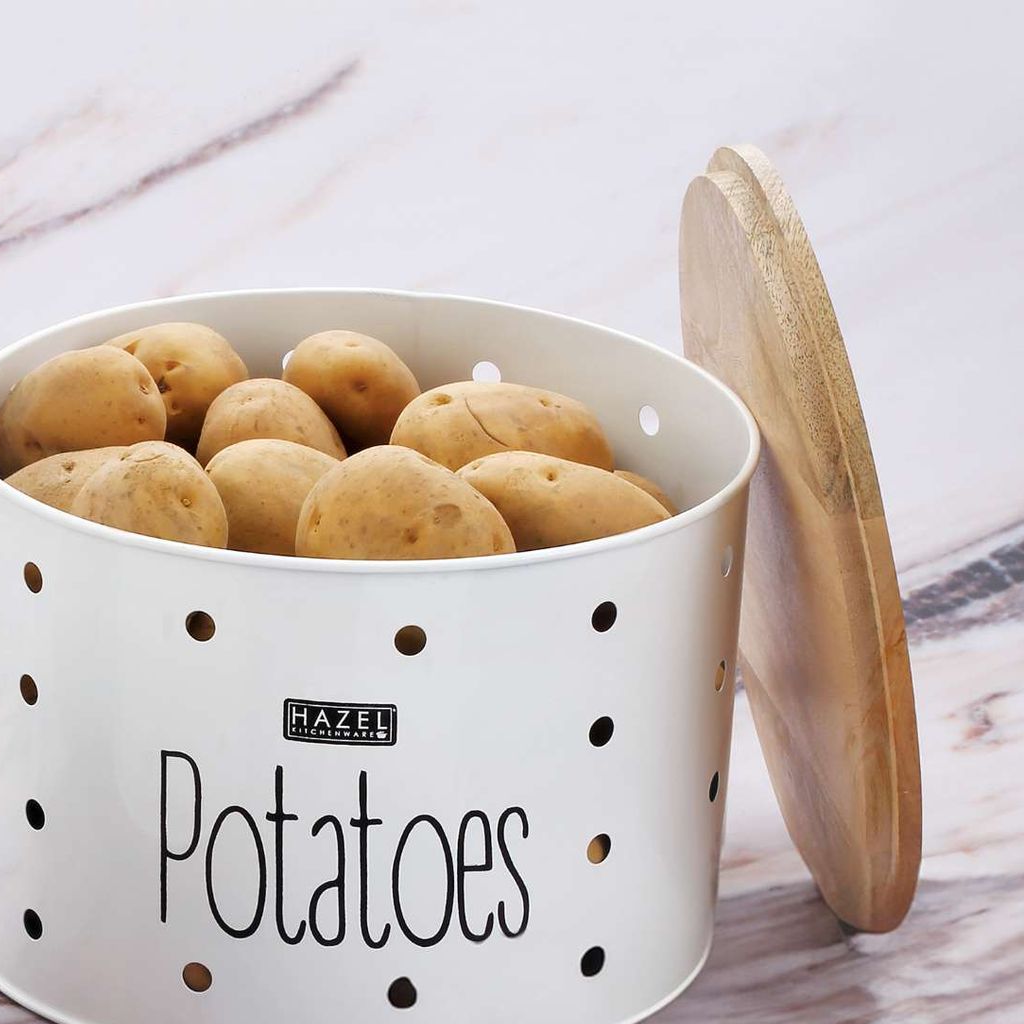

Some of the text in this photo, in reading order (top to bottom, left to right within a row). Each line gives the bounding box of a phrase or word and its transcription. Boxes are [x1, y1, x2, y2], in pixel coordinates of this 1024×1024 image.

[292, 706, 388, 730] HAZEL
[292, 727, 374, 738] KITCHENWARE
[160, 750, 530, 949] Potatoes
